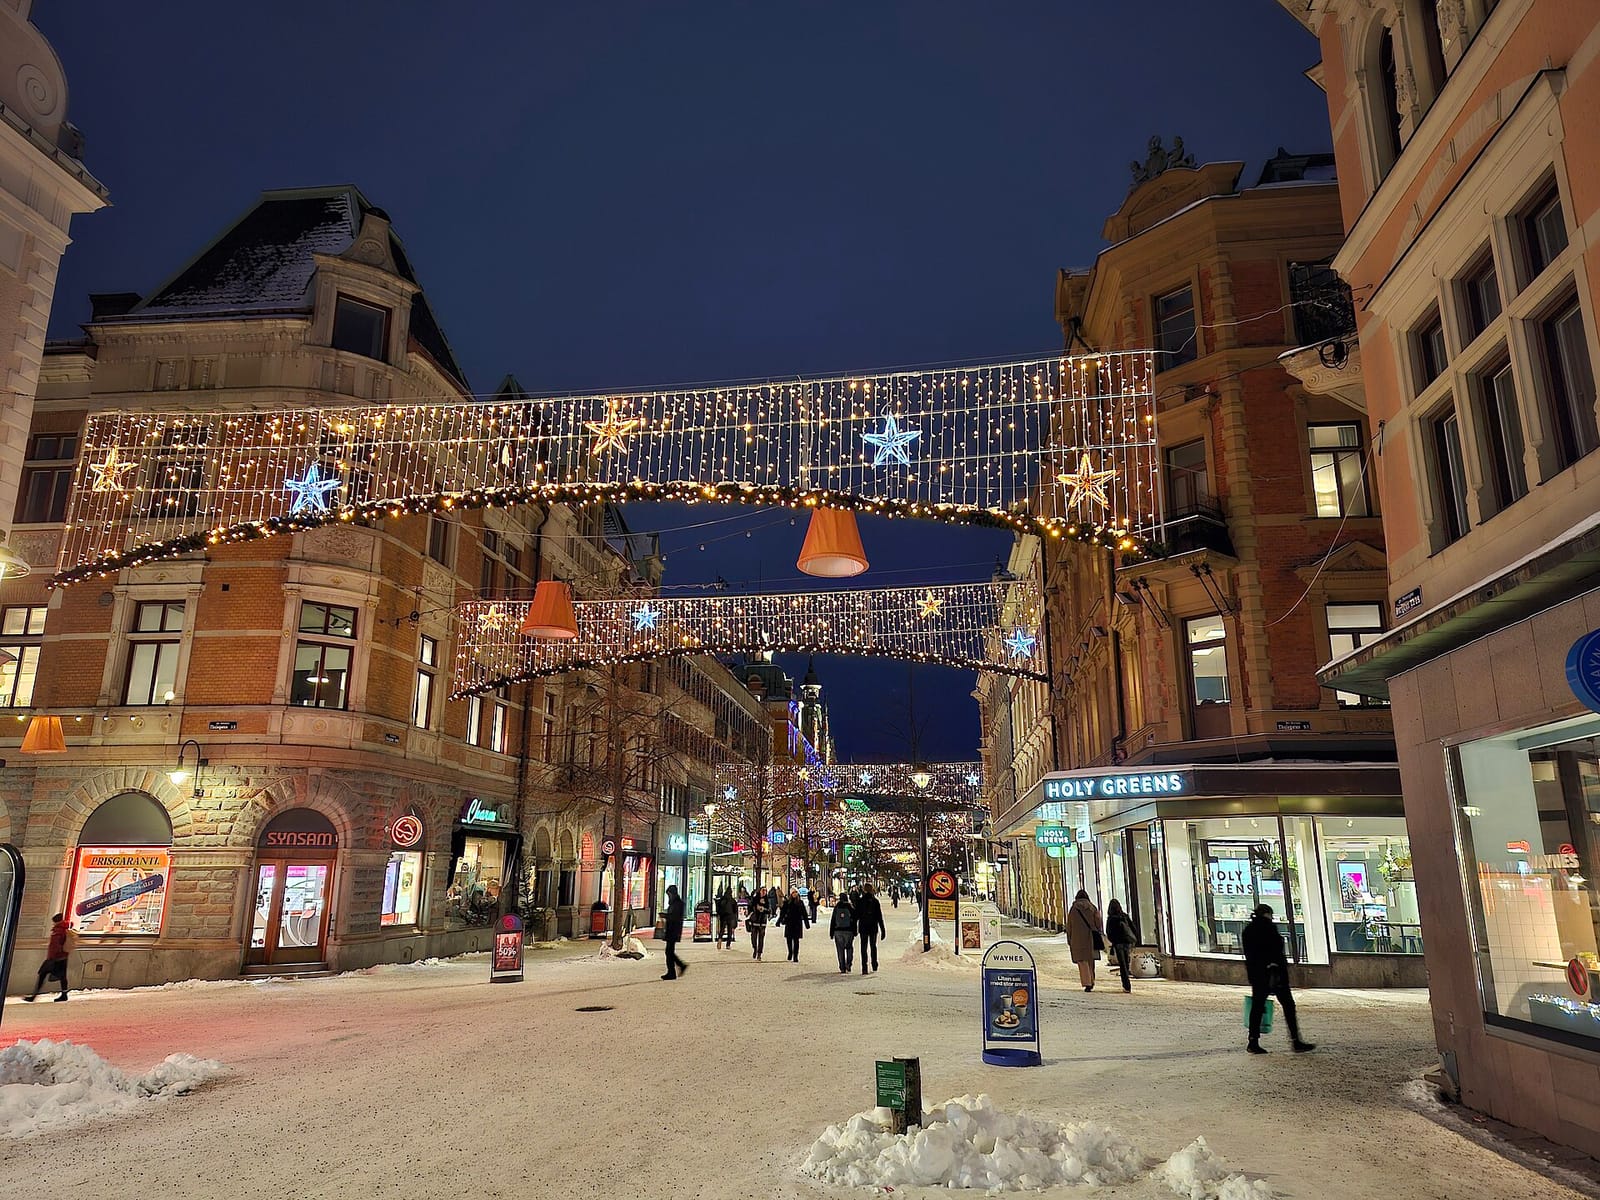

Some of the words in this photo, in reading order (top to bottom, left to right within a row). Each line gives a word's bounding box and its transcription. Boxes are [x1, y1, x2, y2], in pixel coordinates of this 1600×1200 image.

[1048, 780, 1095, 798] HOLY
[1102, 774, 1182, 795] GREENS
[267, 832, 333, 846] SYNSAM
[1038, 836, 1069, 844] GREENS
